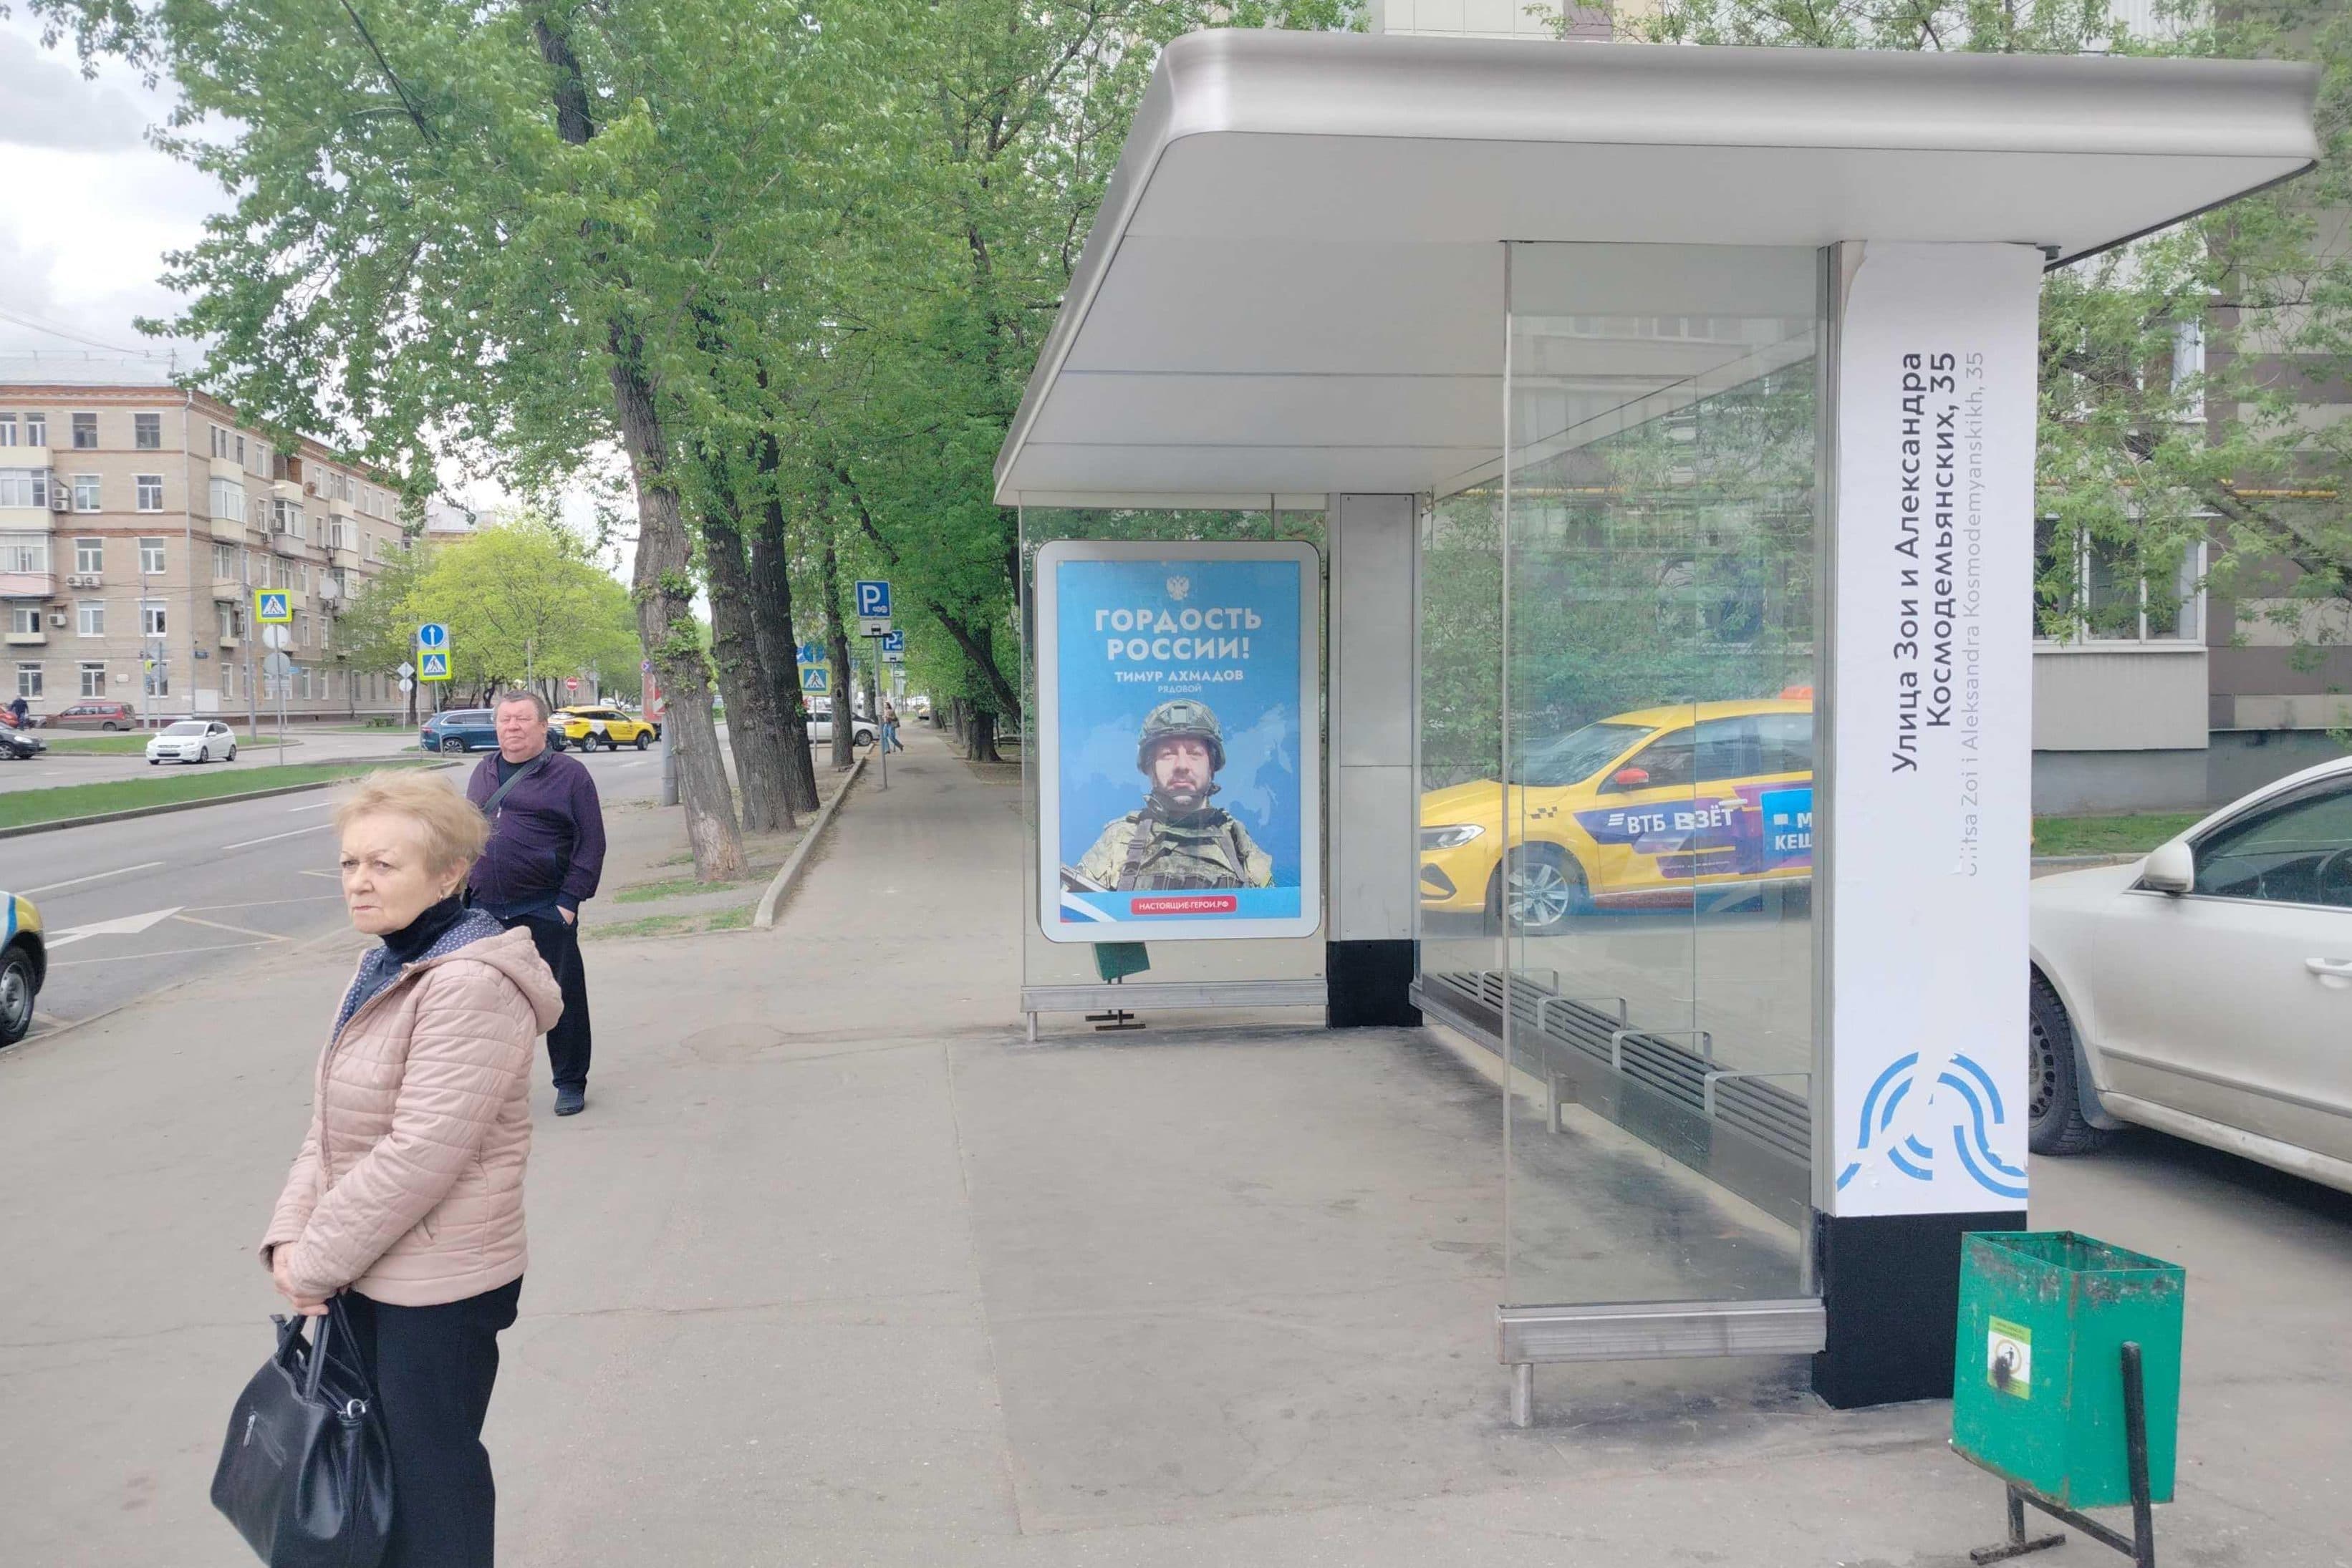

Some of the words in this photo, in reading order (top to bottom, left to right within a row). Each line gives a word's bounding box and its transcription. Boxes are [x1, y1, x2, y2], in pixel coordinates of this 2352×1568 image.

[1930, 353, 1955, 394] 35
[1965, 352, 1984, 379] 35
[1894, 353, 1927, 559] Александра
[1962, 385, 1986, 618] Kosmodemyanskikh,
[1901, 569, 1919, 586] и
[1927, 405, 1960, 726] Космодемьянских,
[862, 585, 881, 614] P
[1095, 608, 1262, 634] ГОРДОСТЬ
[1894, 599, 1919, 660] Зои
[1107, 637, 1250, 661] РОССИИ!
[1114, 671, 1164, 682] ТИМУР
[1169, 669, 1244, 682] АХМАДОВ
[1157, 683, 1202, 693] РЯДОВОЙ
[1960, 625, 1980, 750] Aleksandra
[1892, 672, 1922, 773] Улица
[1961, 772, 1978, 806] Zoi
[1626, 813, 1667, 834] ВТБ
[1139, 900, 1229, 911] НАСТОЯЩИЕ-ГЕРОИ.РФ
